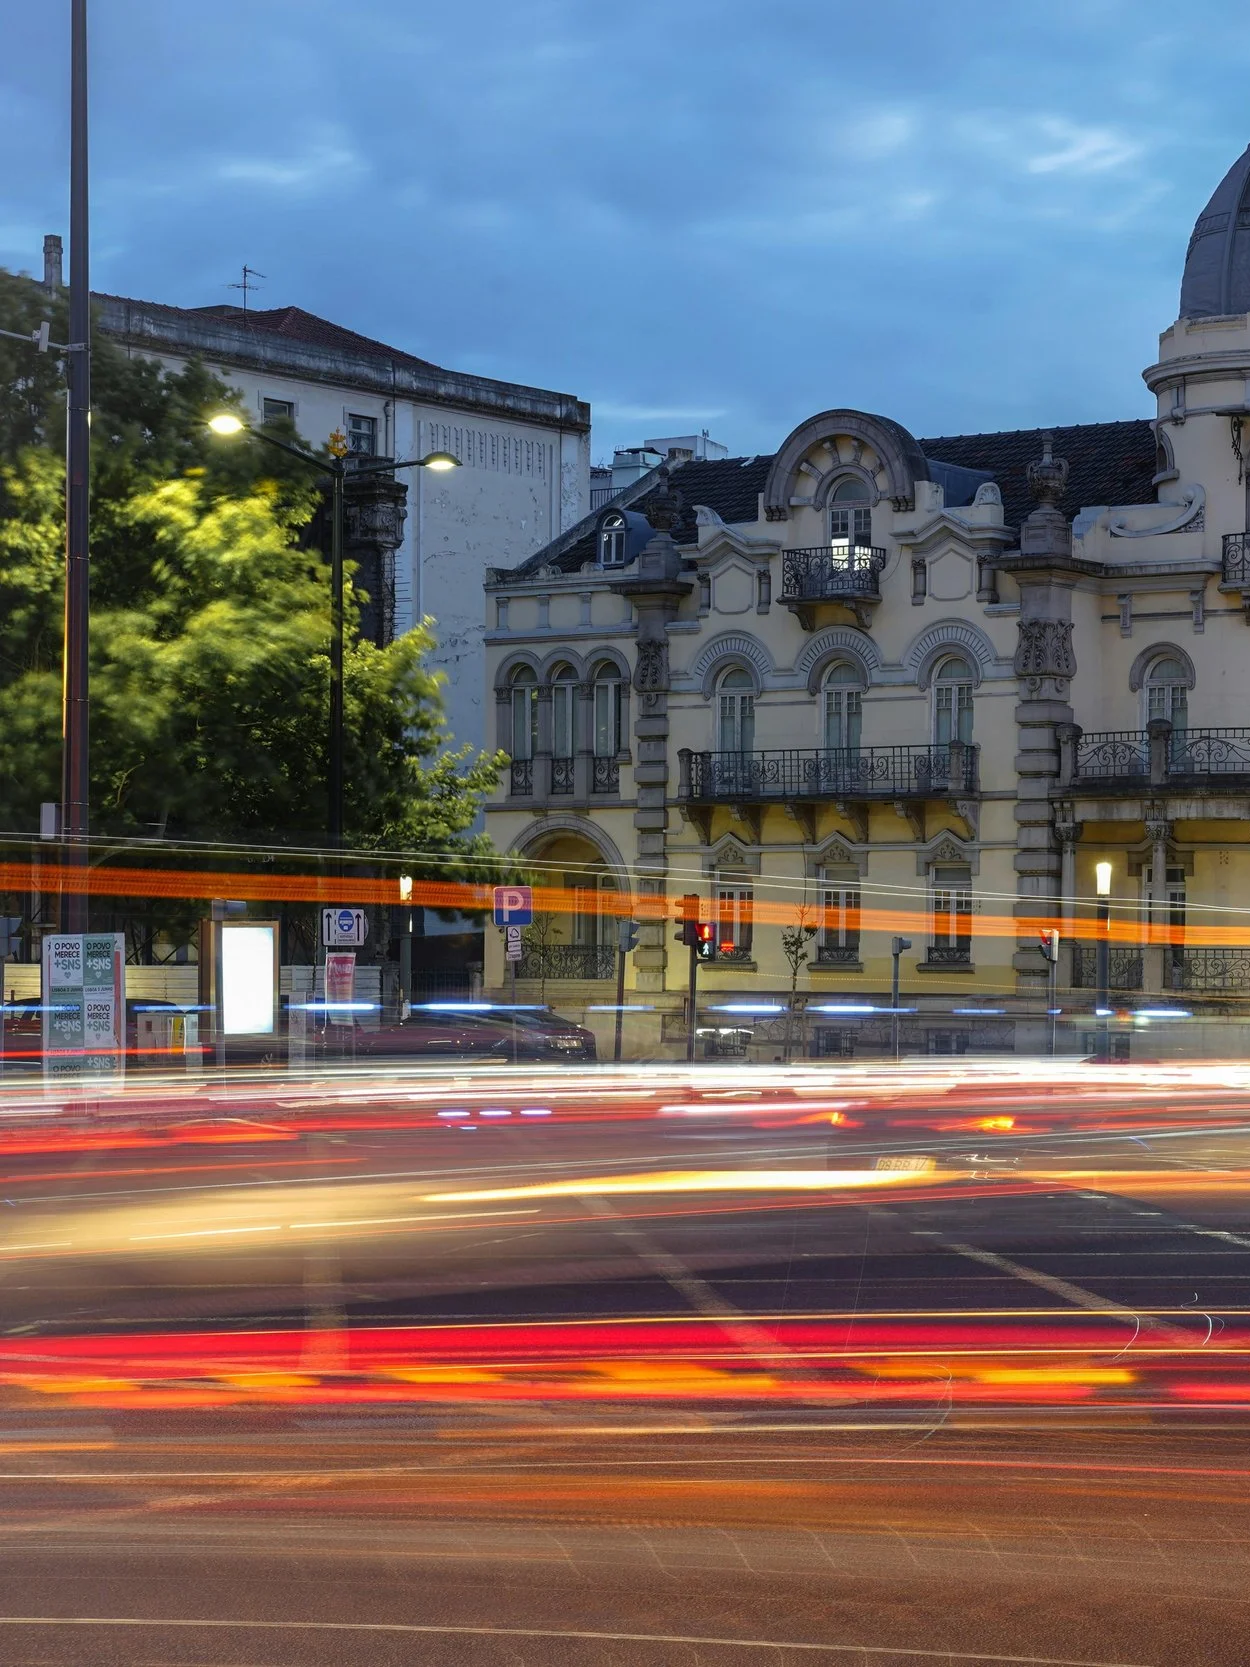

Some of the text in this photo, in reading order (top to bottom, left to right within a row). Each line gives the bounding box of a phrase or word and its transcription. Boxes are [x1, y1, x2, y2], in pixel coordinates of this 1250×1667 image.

[503, 891, 524, 922] P
[54, 950, 81, 958] MERECE
[86, 950, 111, 958] MERECE
[54, 959, 81, 970] +SNS
[86, 958, 112, 970] +SNS
[54, 1012, 81, 1020] MERECE
[87, 1012, 110, 1020] MERECE
[53, 1020, 82, 1032] +SNS
[87, 1020, 111, 1032] +SNS
[87, 1056, 111, 1069] +SNS
